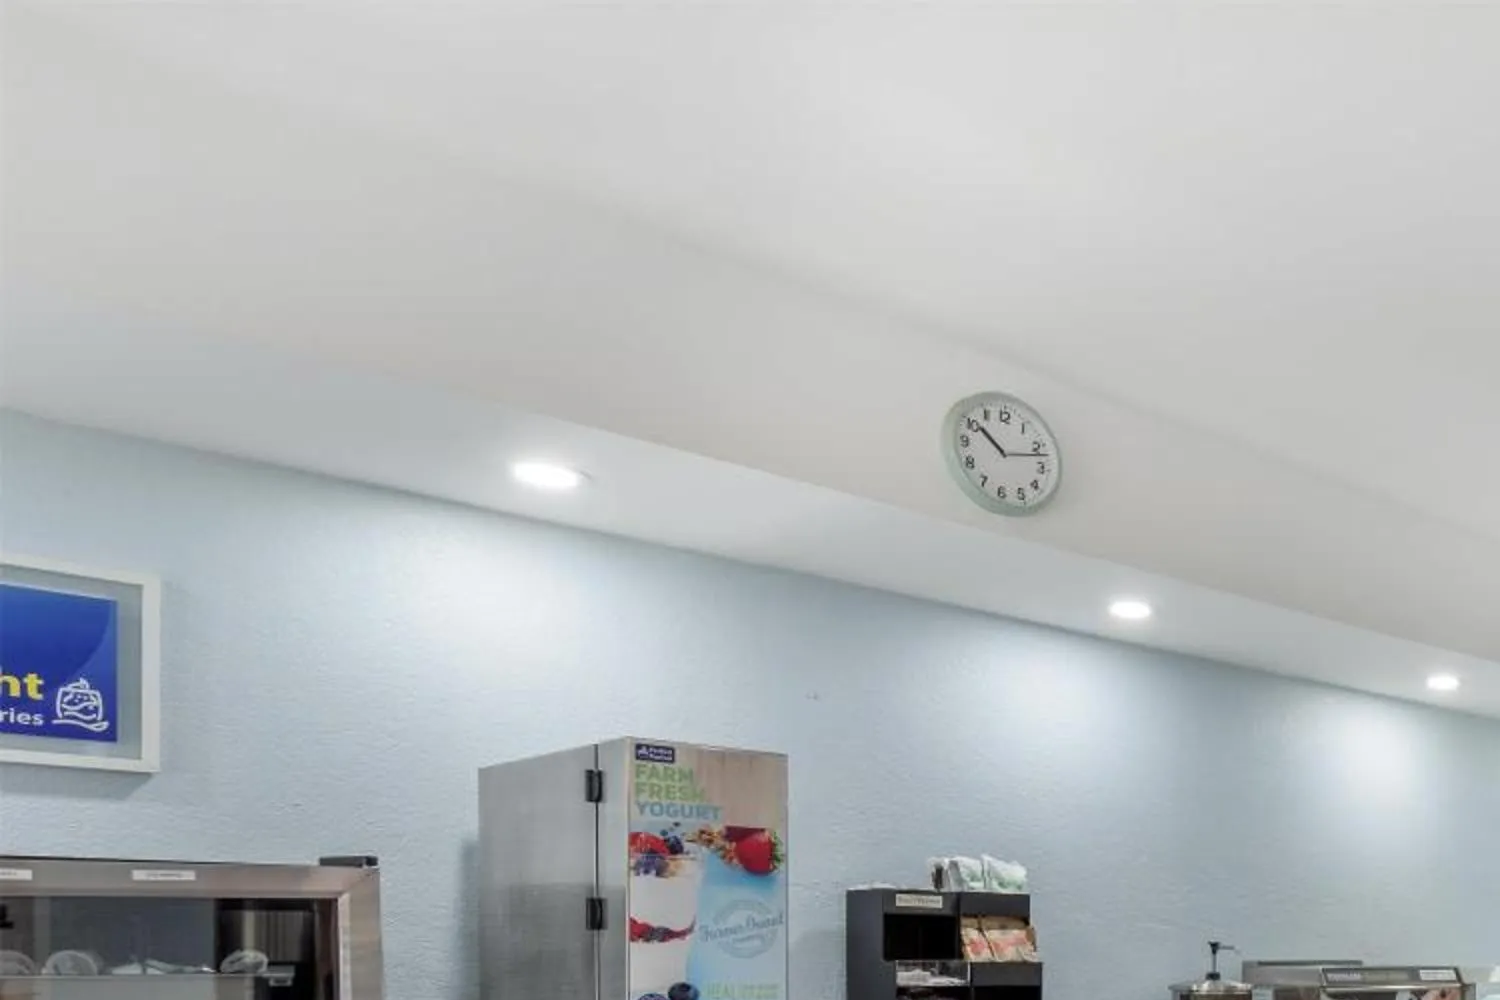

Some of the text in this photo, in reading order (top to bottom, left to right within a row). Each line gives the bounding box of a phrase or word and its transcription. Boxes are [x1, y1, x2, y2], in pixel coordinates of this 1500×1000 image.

[999, 408, 1011, 425] 12
[960, 435, 970, 448] 9
[1032, 441, 1041, 455] 2
[965, 455, 975, 469] 8
[1036, 461, 1045, 475] 3
[980, 474, 988, 487] 7
[1030, 479, 1039, 490] 4
[997, 486, 1007, 499] 6
[1017, 487, 1026, 501] 5
[635, 763, 694, 785] FARM
[635, 781, 706, 803] FRESH
[634, 800, 724, 822] YOGURT
